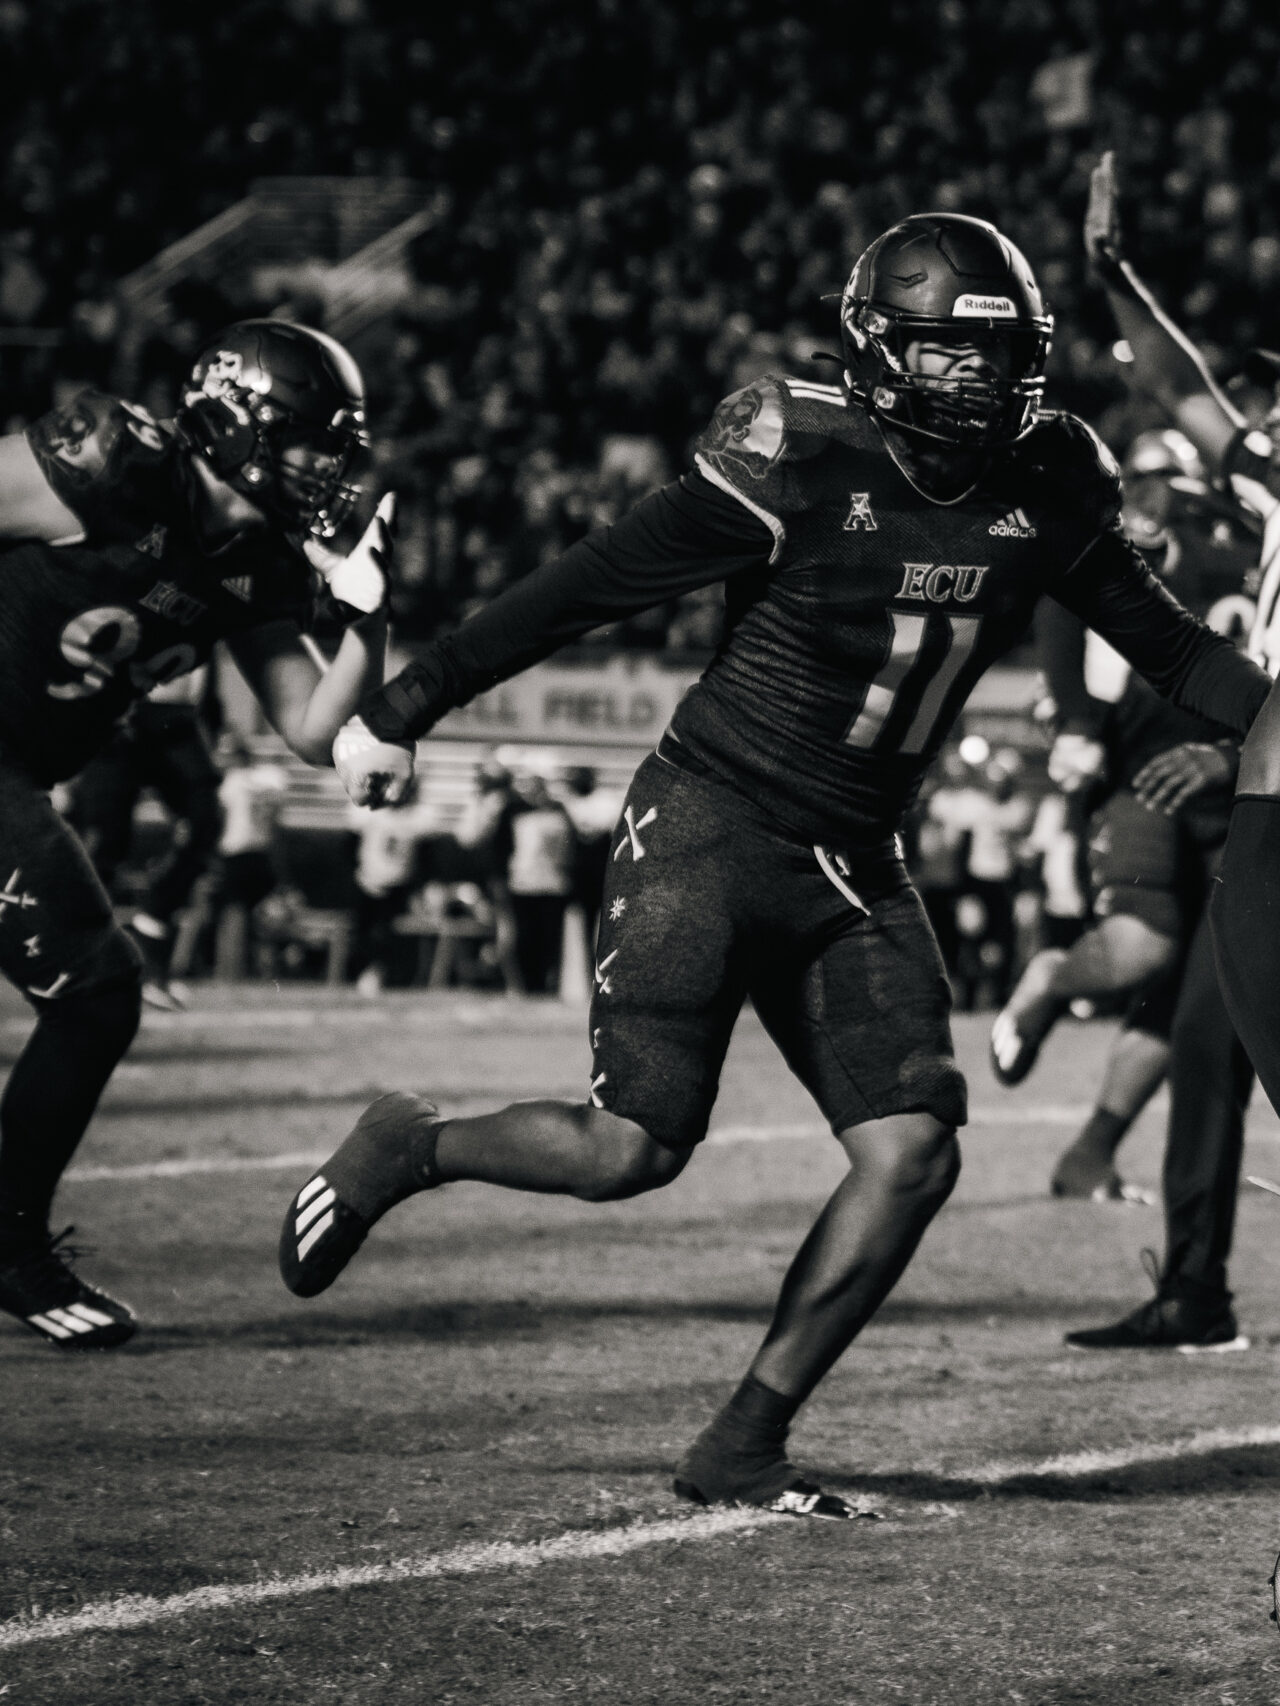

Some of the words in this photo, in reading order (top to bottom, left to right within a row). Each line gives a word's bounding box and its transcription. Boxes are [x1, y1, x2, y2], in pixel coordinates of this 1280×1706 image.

[964, 298, 1010, 311] Riddell
[988, 524, 1037, 539] adidas
[894, 562, 990, 604] ECU
[840, 608, 984, 755] 11
